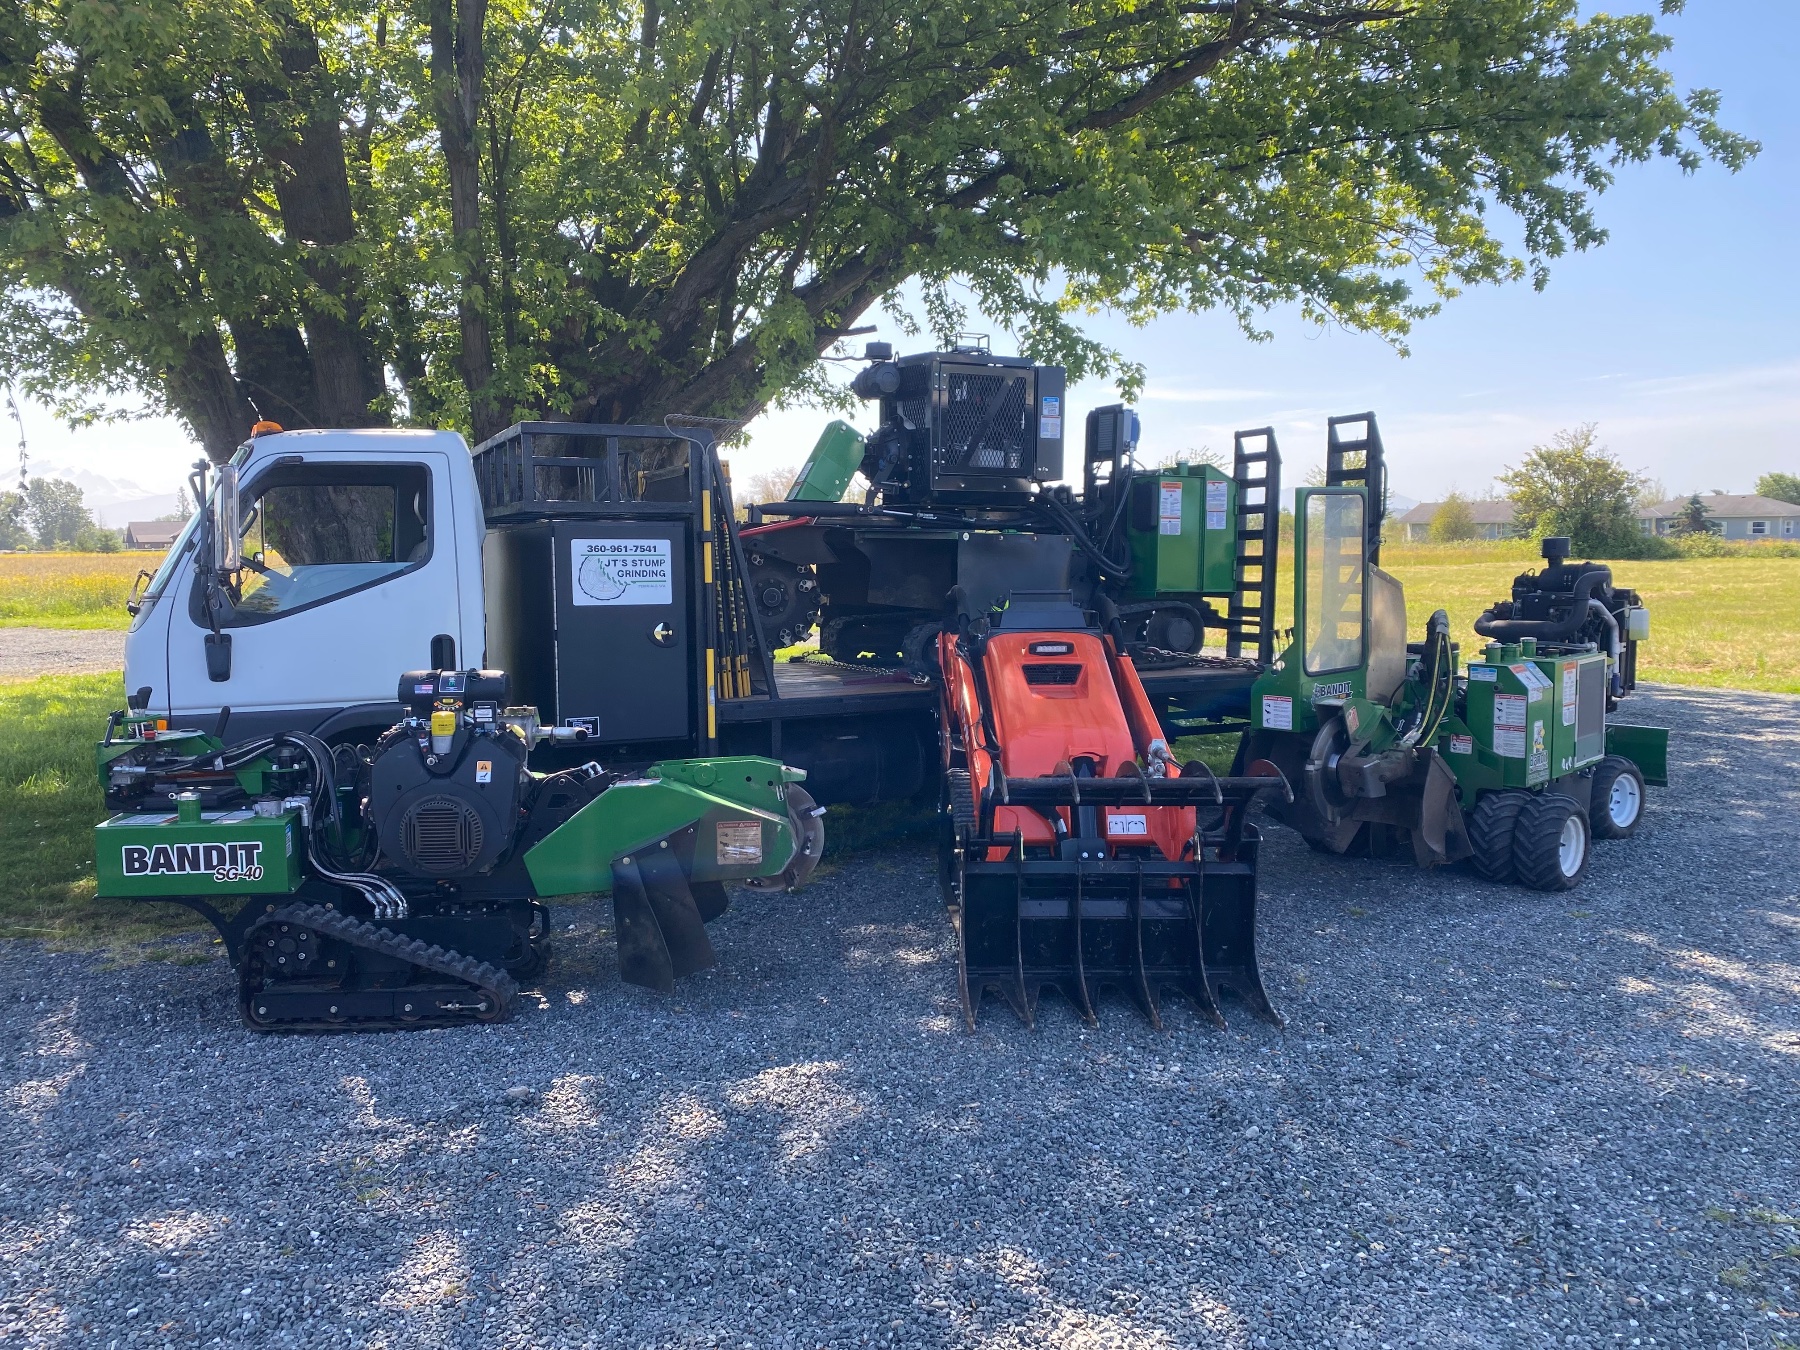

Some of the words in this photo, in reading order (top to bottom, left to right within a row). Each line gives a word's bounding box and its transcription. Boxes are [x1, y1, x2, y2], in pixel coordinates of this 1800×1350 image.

[586, 545, 657, 553] 360-961-7541
[604, 559, 628, 567] JT'S
[631, 559, 666, 567] STUMP
[617, 569, 666, 578] GRINDING
[1320, 682, 1351, 697] BANDIT
[122, 841, 262, 876] BANDIT
[214, 866, 263, 883] SG-40
